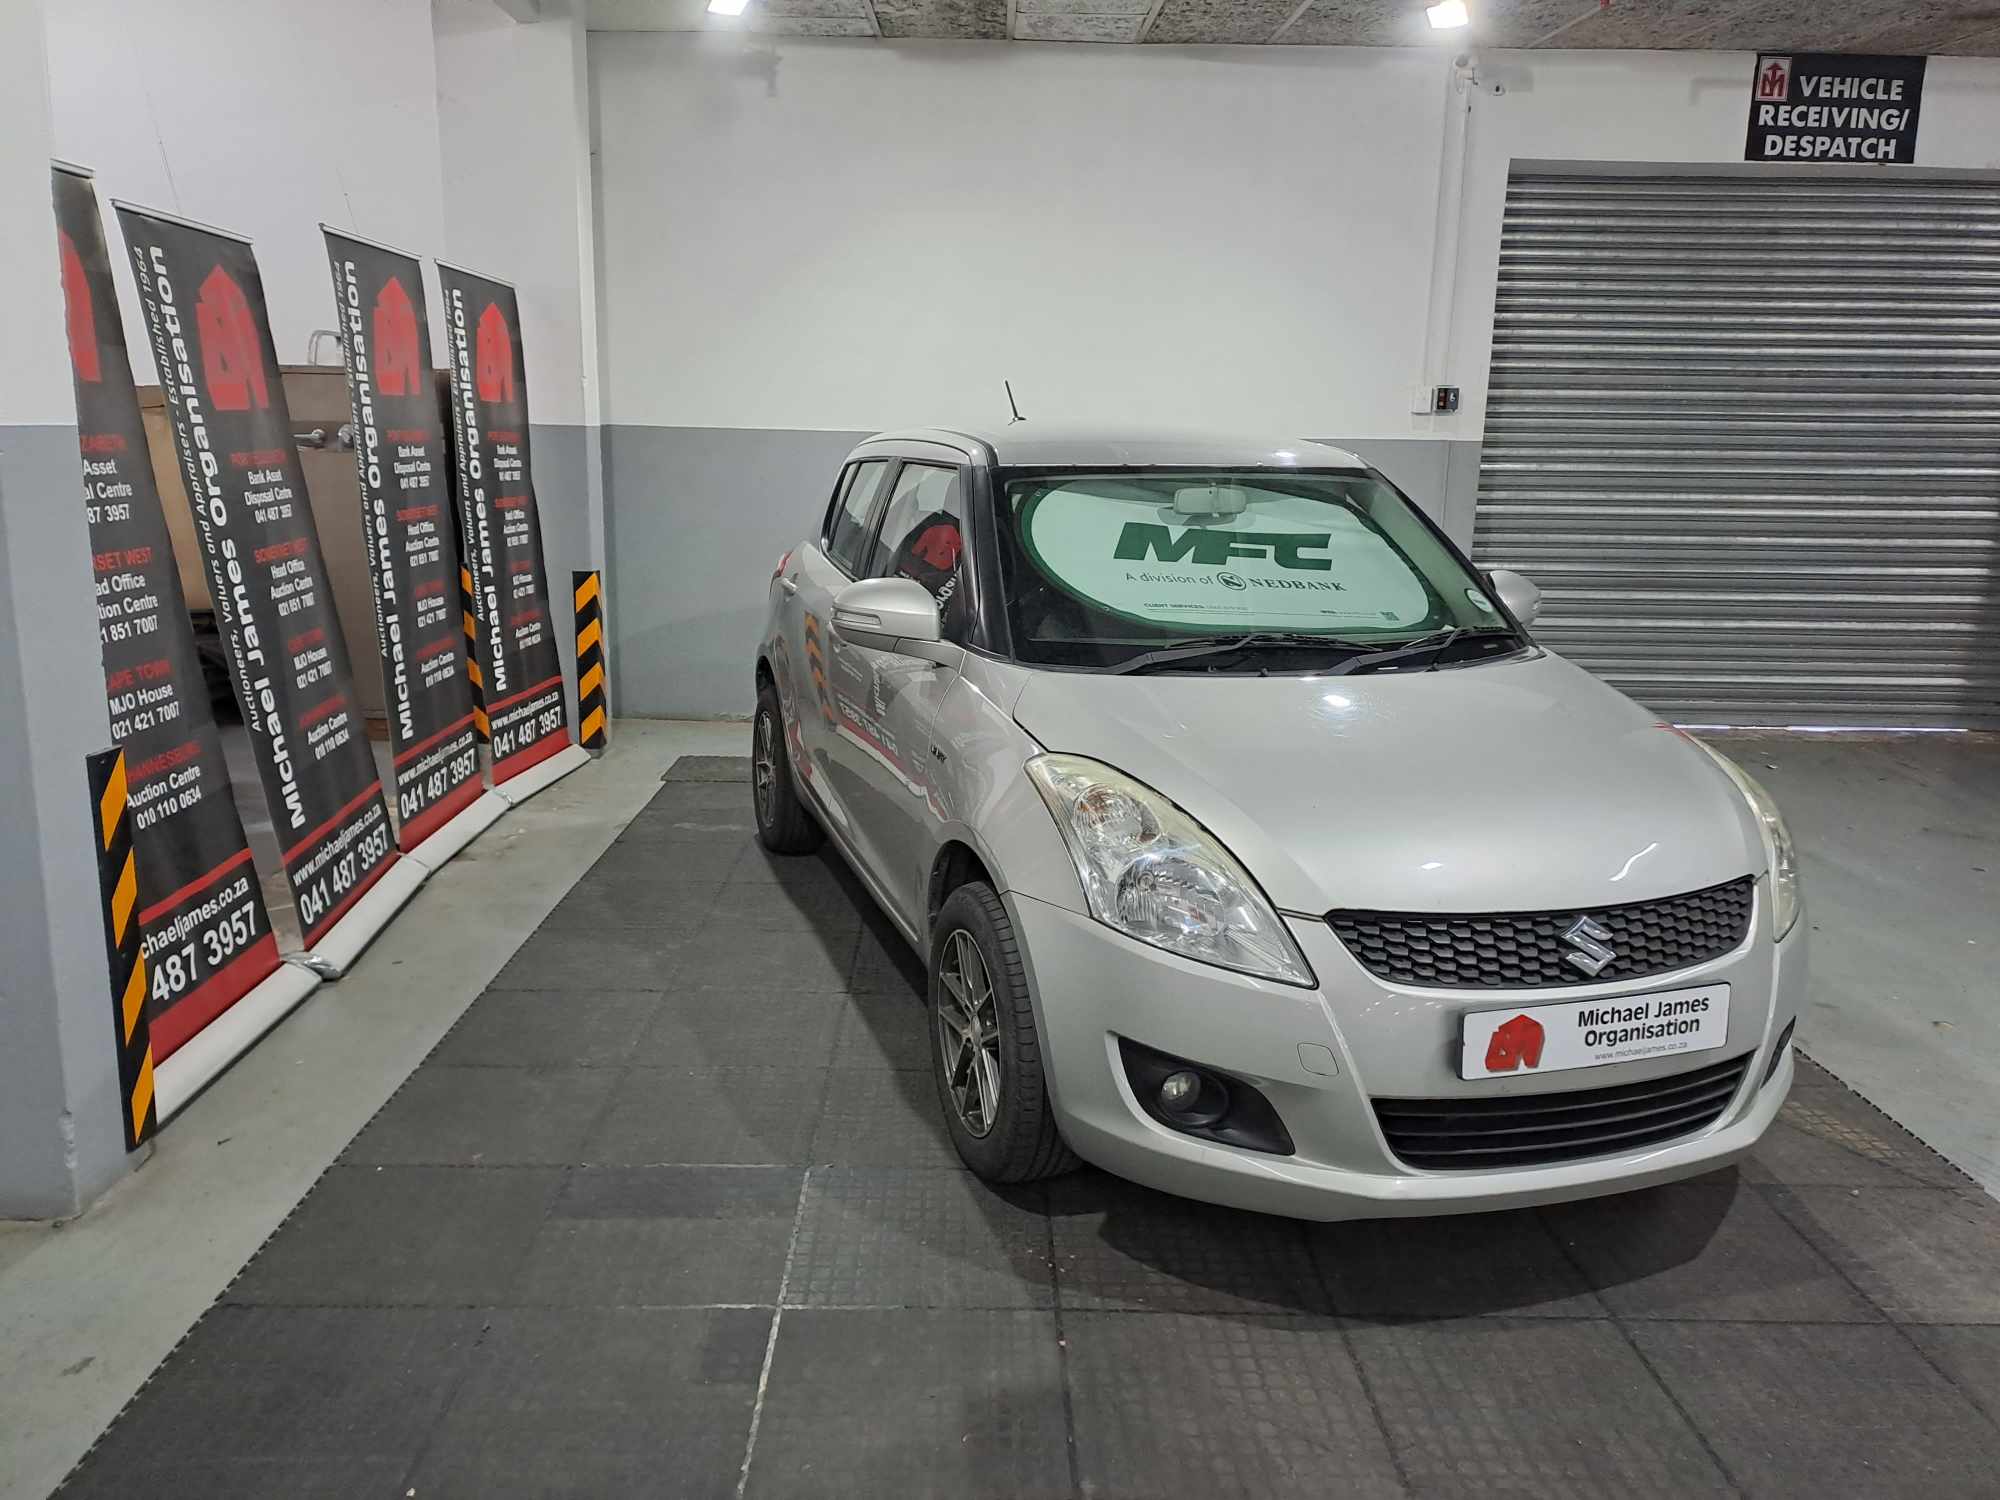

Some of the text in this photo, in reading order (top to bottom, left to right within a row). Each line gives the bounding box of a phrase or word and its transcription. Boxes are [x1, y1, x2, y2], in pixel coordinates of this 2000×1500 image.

[1800, 76, 1904, 100] VEHICLE
[1758, 104, 1911, 131] RECEIVING/
[1764, 135, 1897, 159] DESPATCH
[133, 246, 152, 293] 1964
[145, 299, 178, 405] Established
[452, 289, 481, 480] Organisation
[83, 459, 117, 476] Asset
[177, 421, 207, 517] Appraisers
[97, 482, 132, 498] Centre
[345, 261, 414, 740] Michael James Organisation
[104, 504, 129, 522] 3957
[474, 488, 493, 578] James
[150, 246, 306, 829] Michael James Organisation
[200, 519, 216, 554] and
[1112, 521, 1332, 571] MFC
[111, 573, 145, 592] Office
[211, 559, 232, 622] Valuers
[1126, 571, 1347, 592] A division of NEDBANK
[123, 595, 158, 613] Centre
[110, 622, 132, 640] 851
[484, 585, 506, 691] Michael
[109, 684, 173, 715] MJO House
[230, 630, 262, 732] Auctioneers,
[112, 701, 180, 739] 021 421 7007
[494, 706, 561, 758] 041 487 3957
[127, 765, 201, 809] Auction Centre
[400, 748, 475, 819] 041 487 3957
[136, 786, 202, 830] 010 110 0634
[300, 822, 389, 925] 041 487 3957
[152, 901, 256, 1001] 487 3957
[1578, 996, 1709, 1028] Michael James
[1584, 1016, 1700, 1048] Organisation
